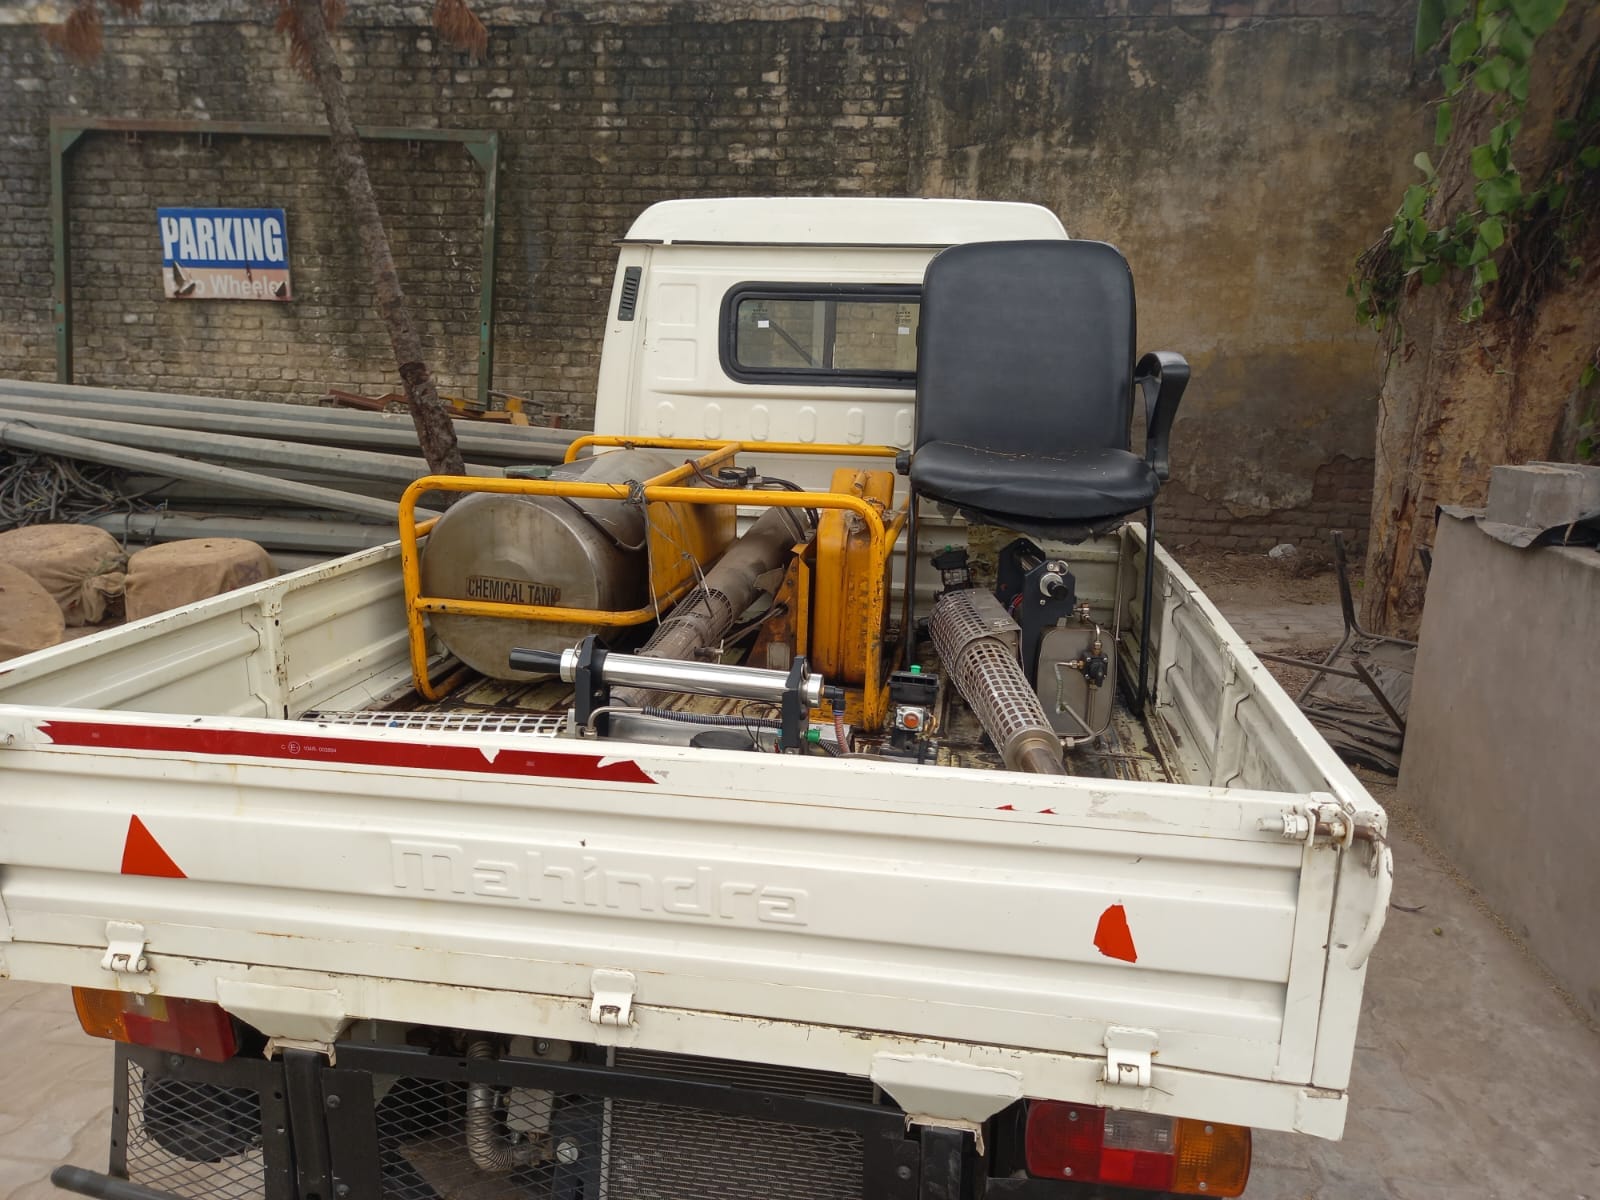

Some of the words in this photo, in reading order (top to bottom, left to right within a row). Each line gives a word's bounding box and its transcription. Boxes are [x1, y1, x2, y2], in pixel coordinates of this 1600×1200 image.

[160, 217, 284, 262] PARKING
[209, 274, 286, 297] Wheele
[468, 578, 524, 603] CHEMICAL
[528, 585, 561, 606] TANK
[390, 840, 809, 927] mahindra
